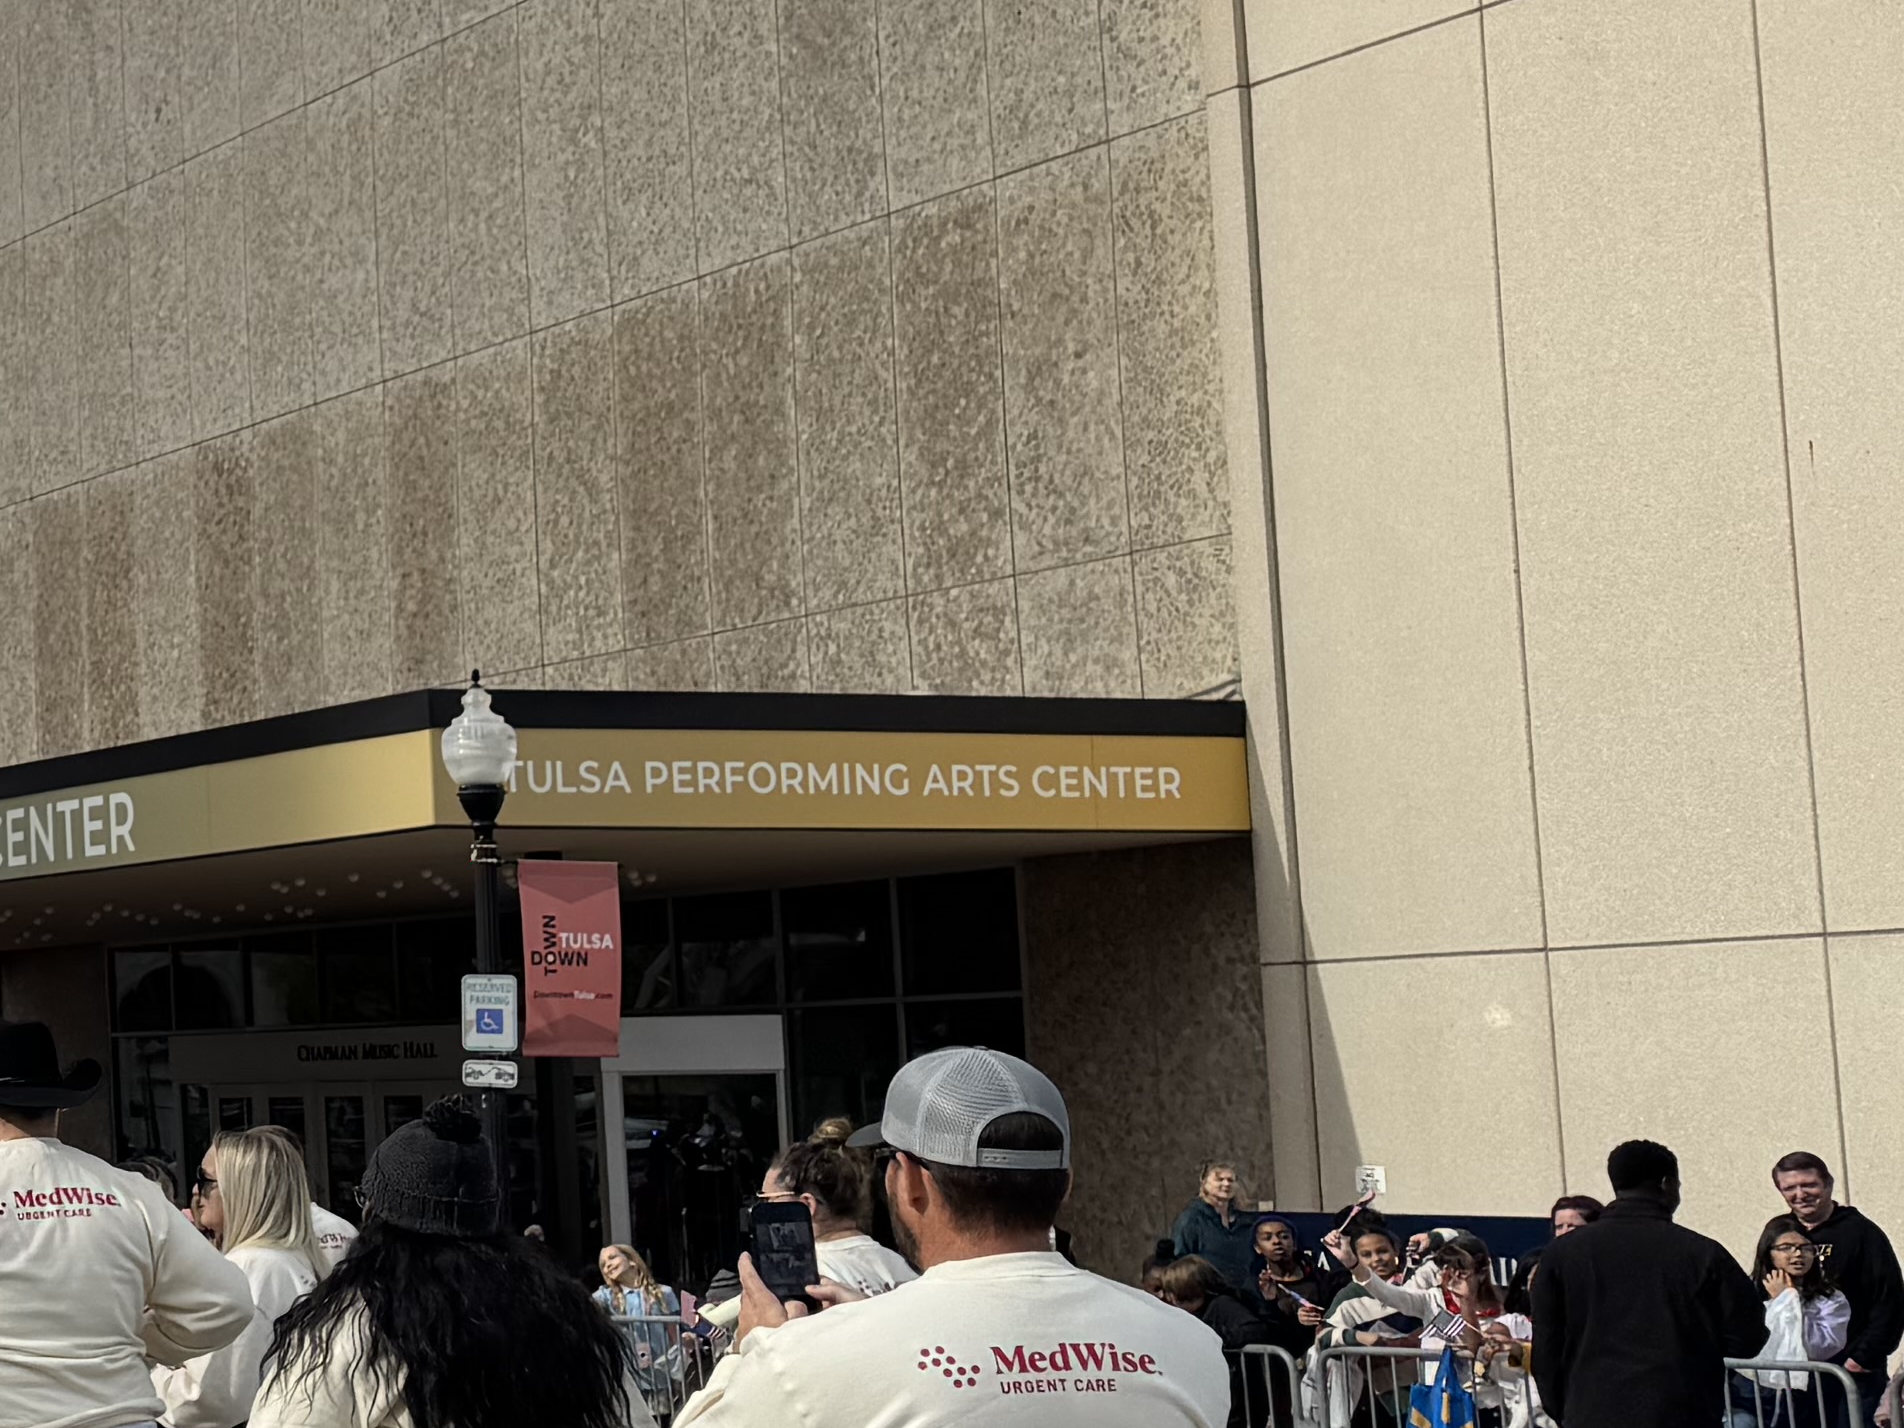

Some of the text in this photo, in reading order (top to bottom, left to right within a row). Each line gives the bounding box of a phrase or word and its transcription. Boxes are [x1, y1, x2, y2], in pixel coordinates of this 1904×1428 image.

[503, 760, 1182, 800] TULSA PERFORMING ARTS CENTER
[558, 932, 613, 949] TULSA
[530, 950, 588, 967] DOWN
[361, 1042, 401, 1060] MUSIC
[403, 1041, 438, 1059] HALL
[13, 1187, 120, 1208] MedWise
[990, 1342, 1162, 1375] MedWise
[1000, 1378, 1117, 1395] URGENT CARE
